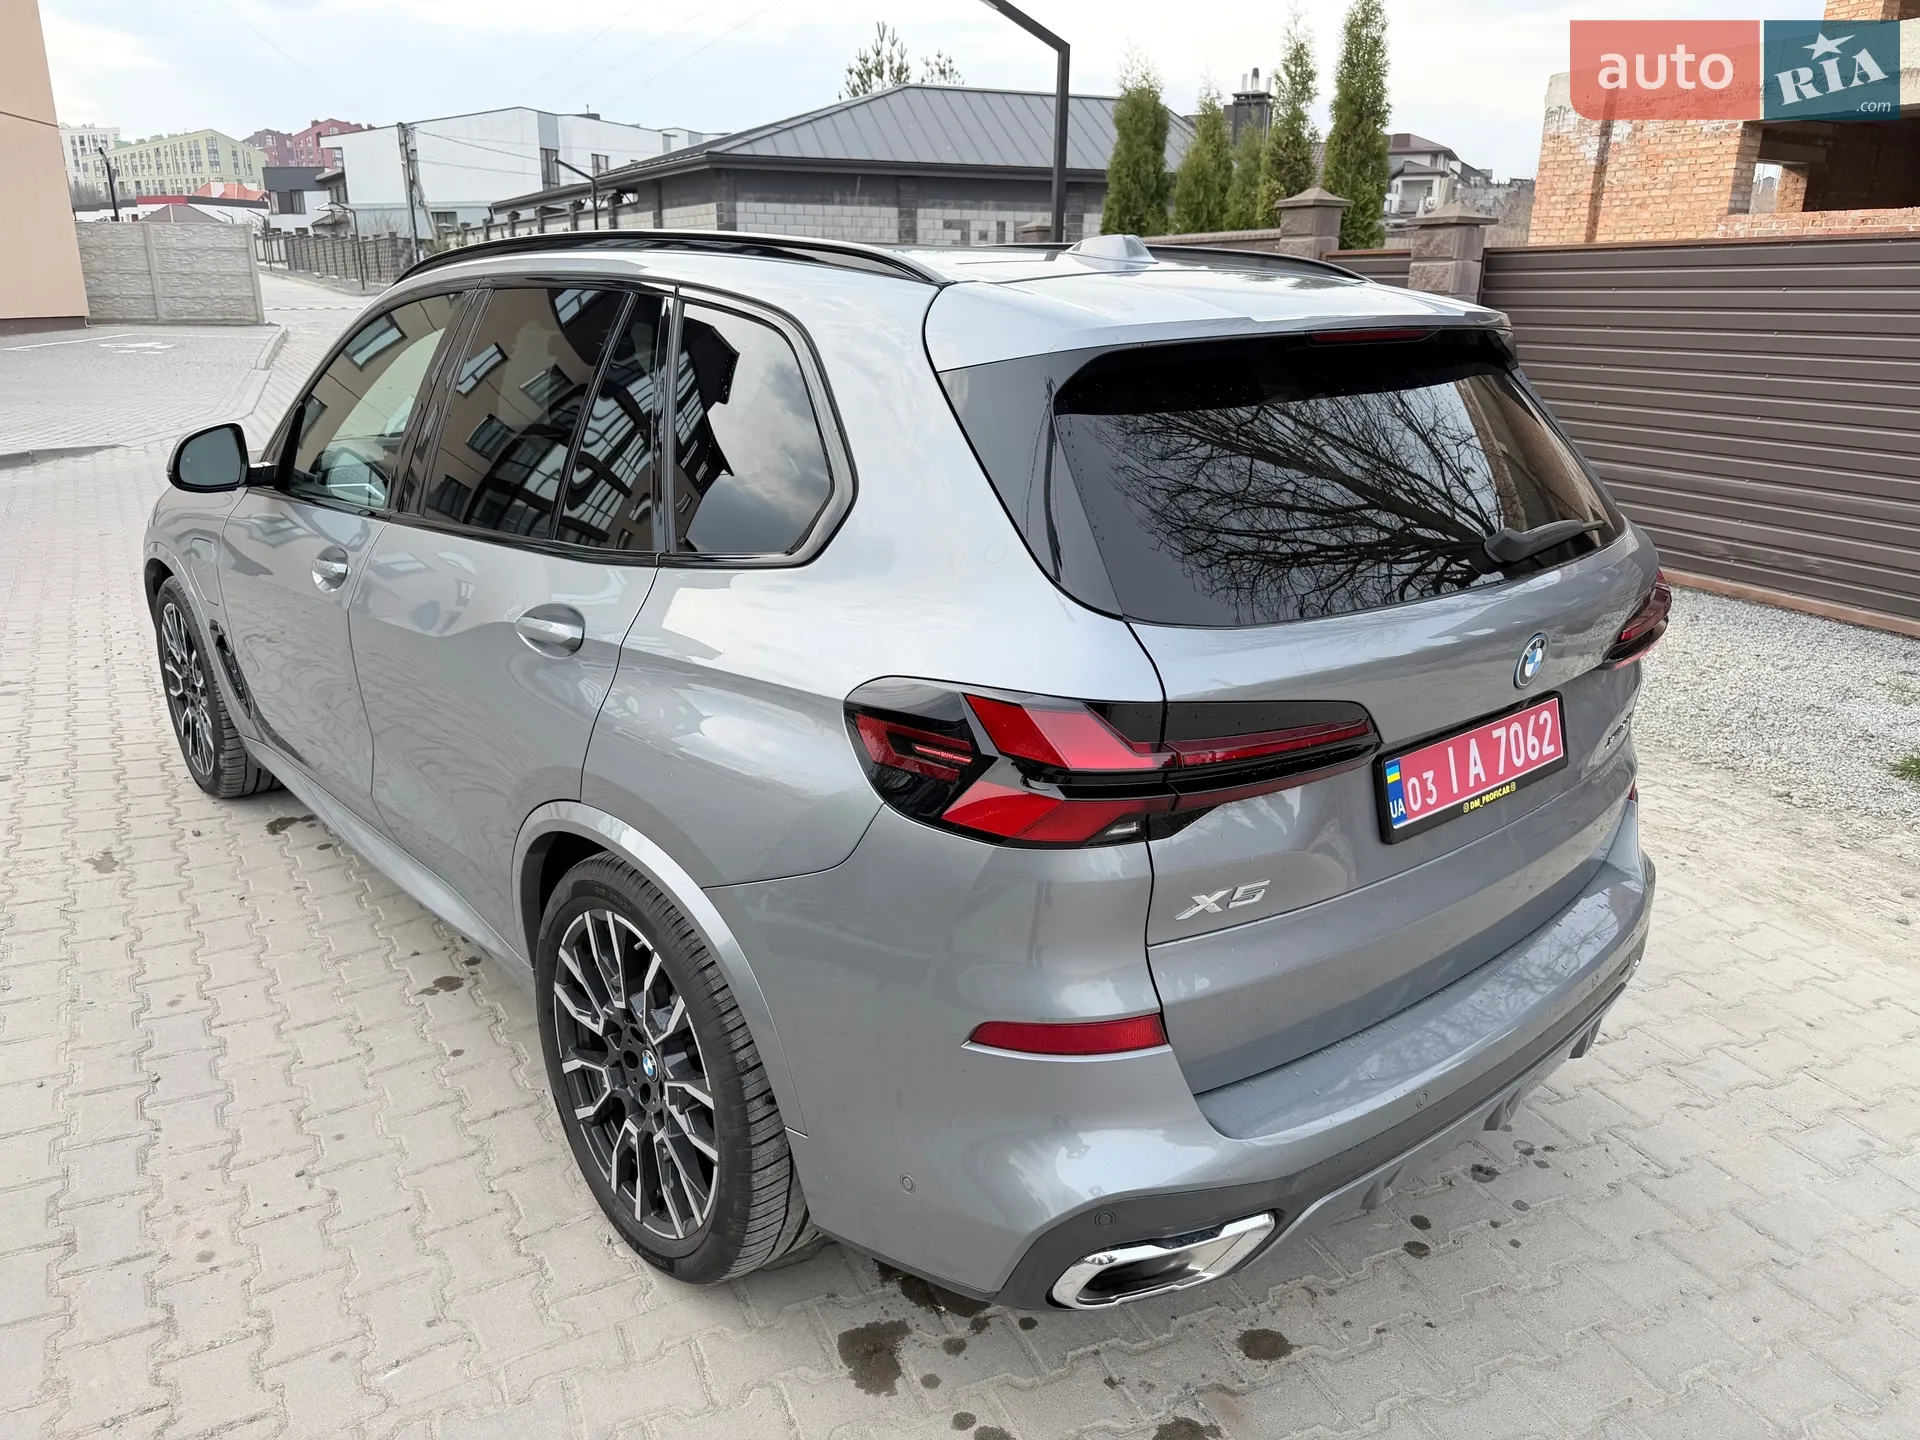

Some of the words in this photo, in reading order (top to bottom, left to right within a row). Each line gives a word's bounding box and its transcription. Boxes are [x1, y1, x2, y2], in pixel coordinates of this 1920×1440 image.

[1407, 770, 1437, 812] 03
[1492, 710, 1555, 776] 7062
[1390, 798, 1406, 818] UA
[1175, 880, 1270, 920] X5
